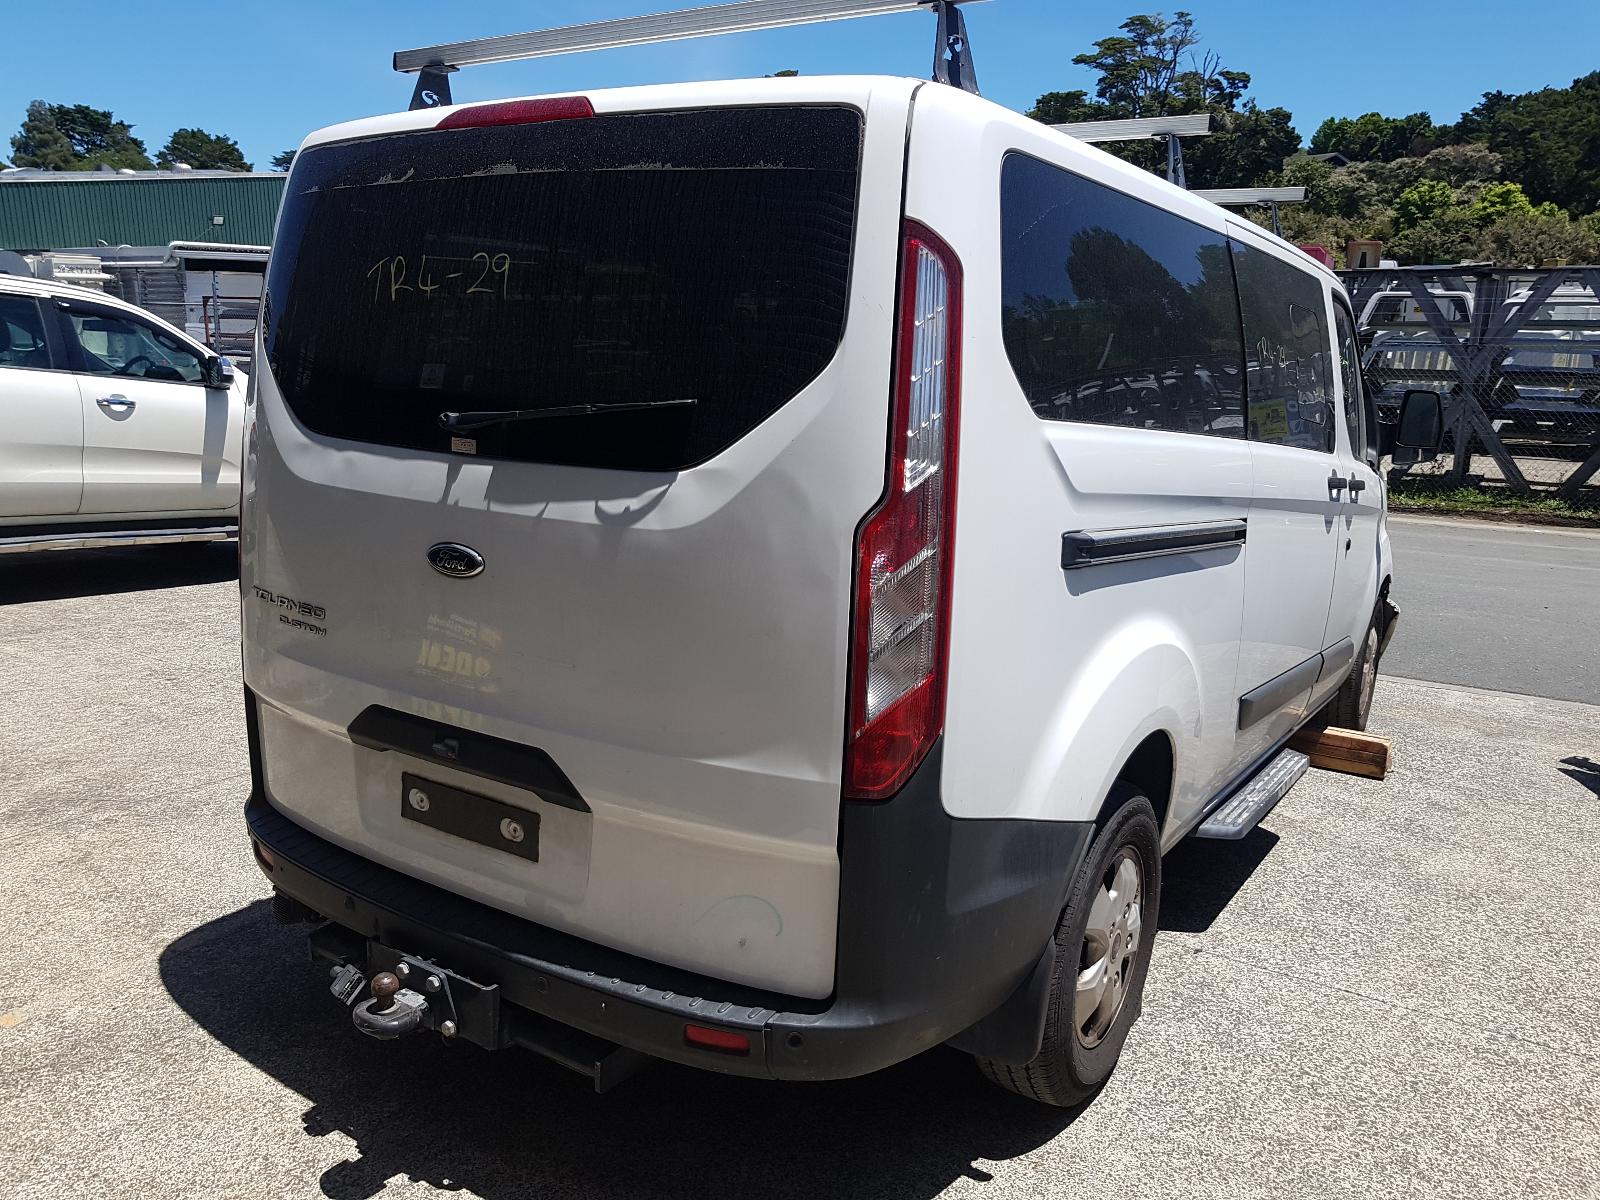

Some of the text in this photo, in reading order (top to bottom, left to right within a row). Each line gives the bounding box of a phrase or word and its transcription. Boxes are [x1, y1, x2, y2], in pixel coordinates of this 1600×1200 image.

[367, 252, 510, 304] TR4-29
[437, 550, 467, 570] Ford
[252, 585, 326, 620] TOURNEO
[279, 614, 327, 636] CUSTOM
